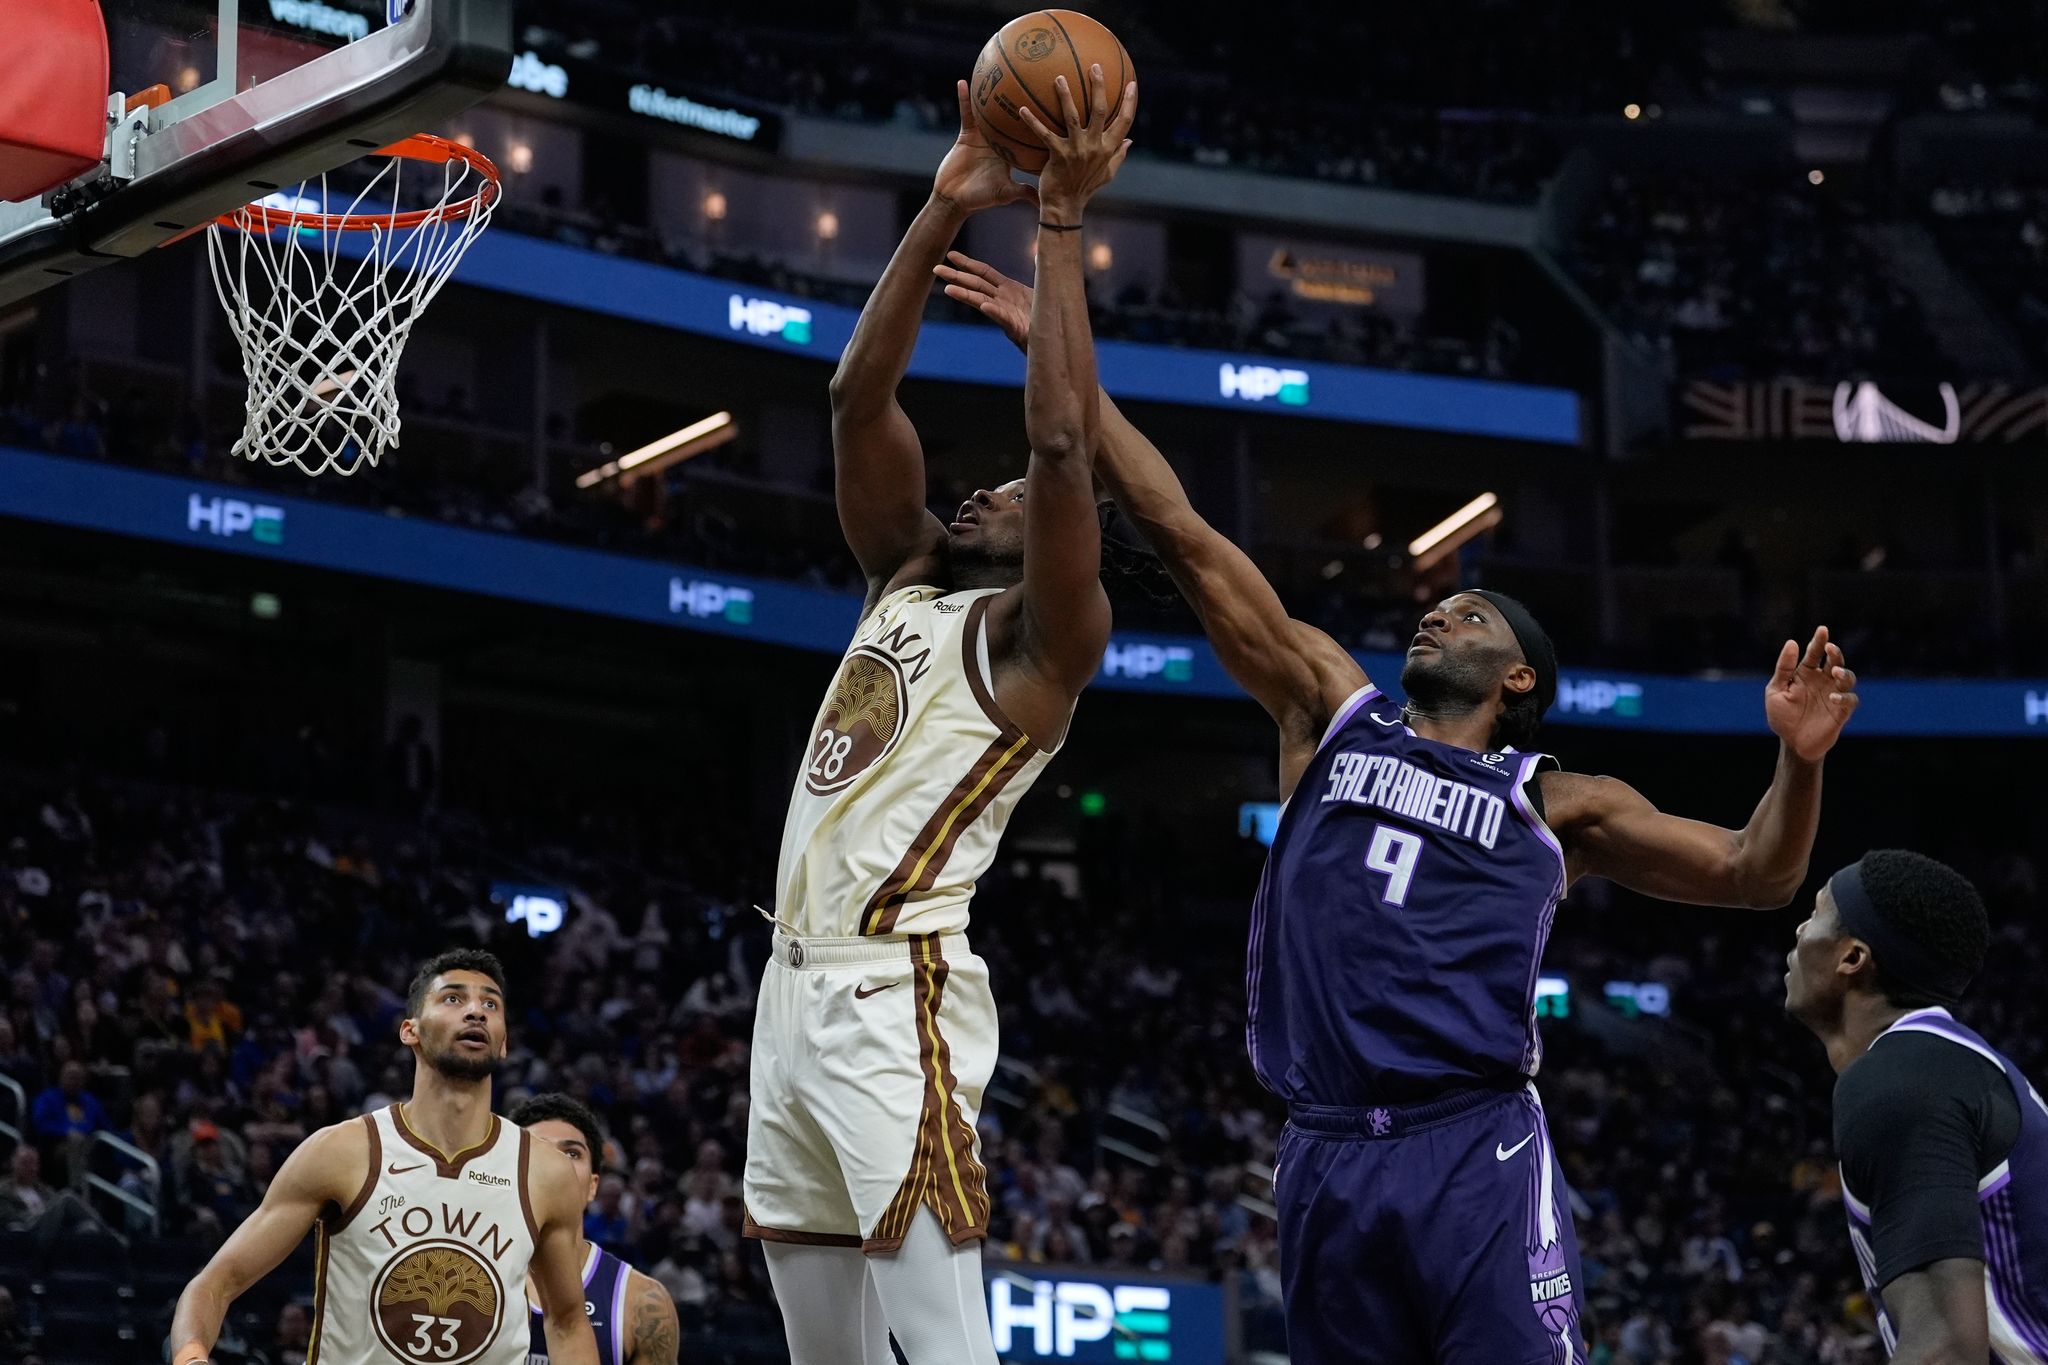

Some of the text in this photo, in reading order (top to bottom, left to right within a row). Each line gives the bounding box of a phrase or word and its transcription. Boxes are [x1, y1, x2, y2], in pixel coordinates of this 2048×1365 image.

[729, 294, 812, 345] HPE
[1219, 362, 1309, 407] HPE
[188, 493, 285, 545] HPE
[669, 577, 754, 625] HPE
[1103, 640, 1195, 682] HPE
[1558, 677, 1642, 717] HPE
[809, 728, 852, 780] 28
[1321, 752, 1505, 850] SACRAMENTO
[1364, 822, 1424, 908] 9
[468, 1170, 511, 1187] Rakuten
[378, 1194, 406, 1215] The
[369, 1202, 514, 1262] TOWN
[1530, 1272, 1572, 1302] KINGS
[407, 1313, 462, 1359] 33
[991, 1277, 1171, 1361] HPE
